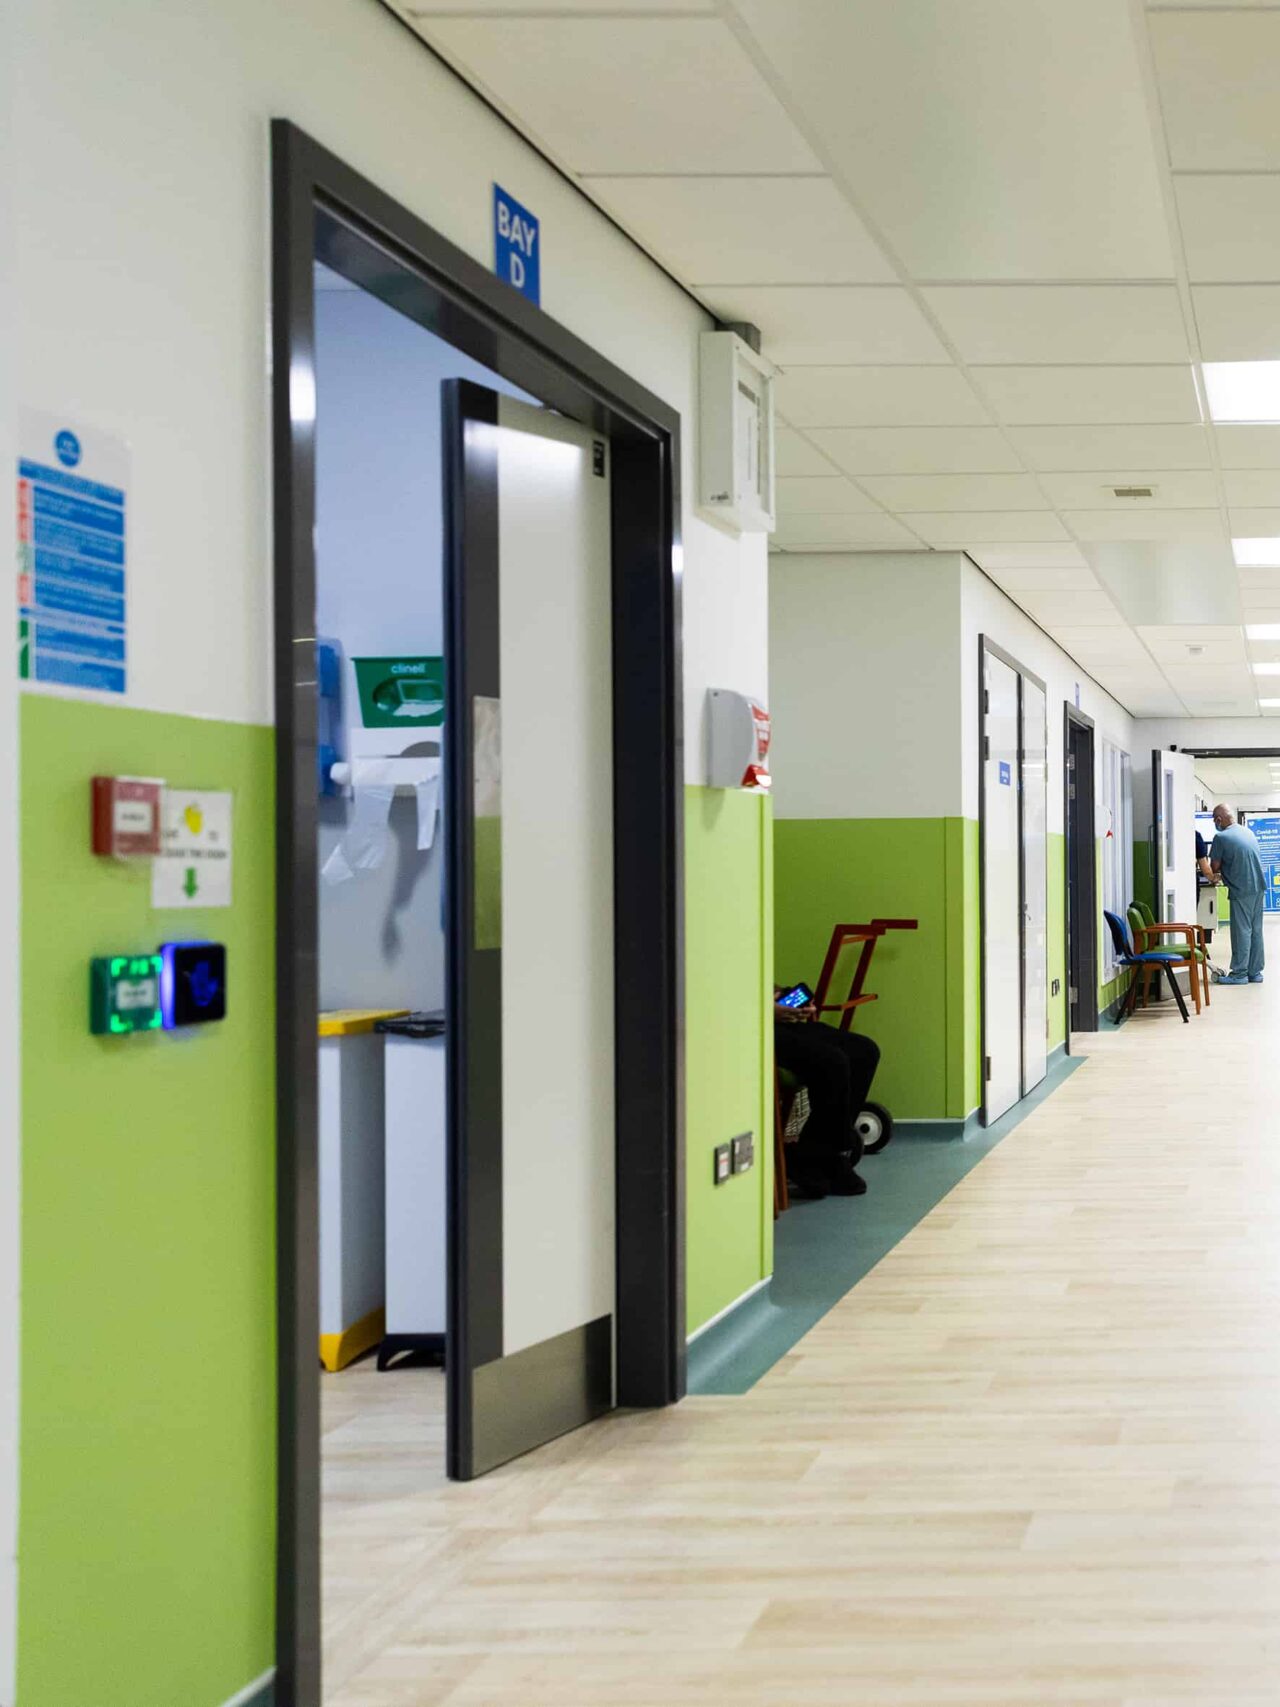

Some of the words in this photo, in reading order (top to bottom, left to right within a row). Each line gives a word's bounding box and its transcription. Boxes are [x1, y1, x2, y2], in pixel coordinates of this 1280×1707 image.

[497, 200, 536, 257] BAY
[510, 252, 525, 288] D
[391, 663, 426, 673] clinell
